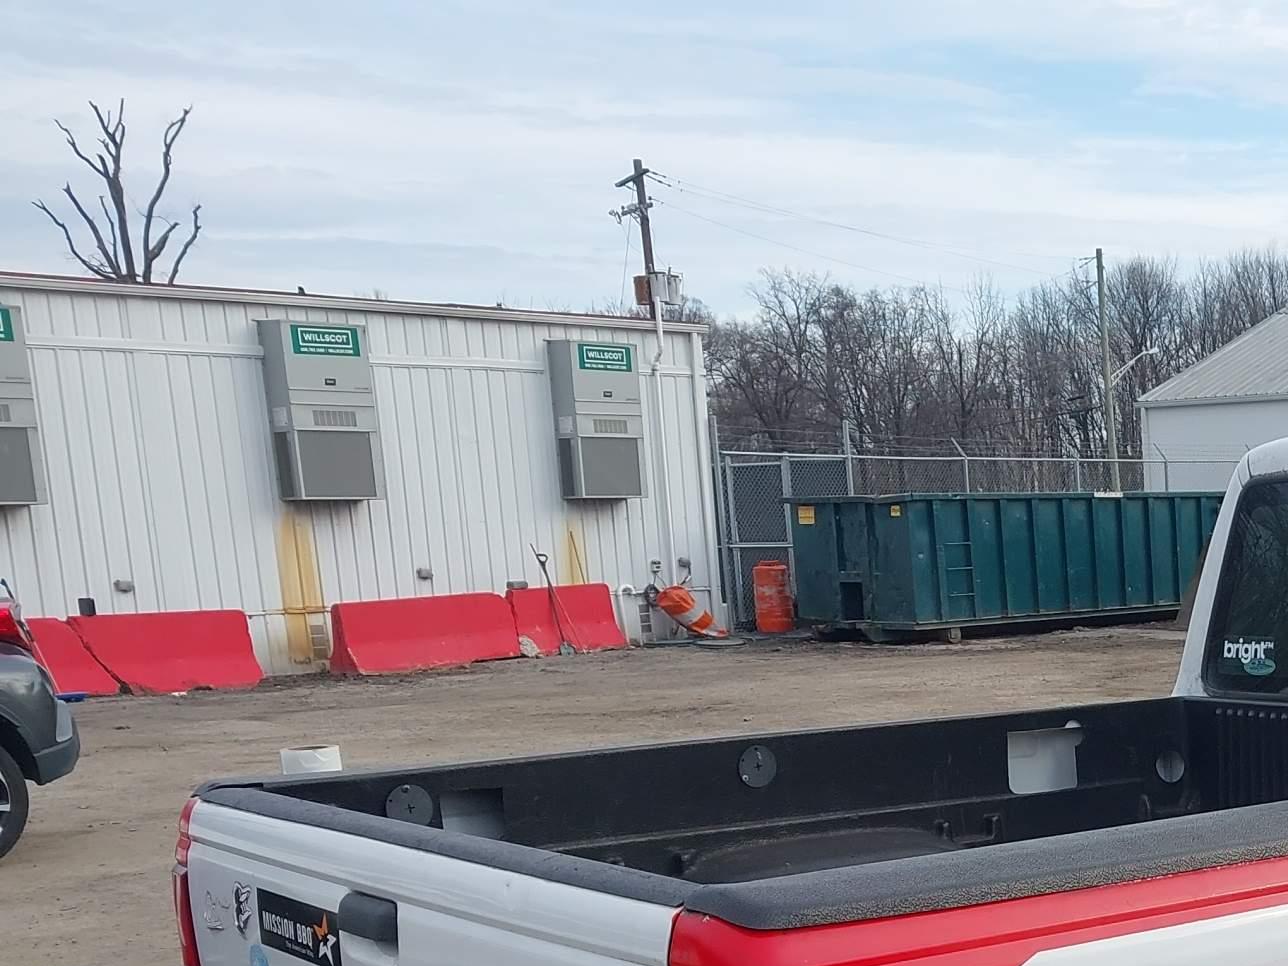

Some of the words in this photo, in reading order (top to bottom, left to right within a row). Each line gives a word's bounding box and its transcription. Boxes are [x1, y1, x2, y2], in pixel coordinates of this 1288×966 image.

[302, 331, 347, 343] WILLSCOT
[586, 350, 623, 360] WILLSCOT
[262, 910, 295, 941] MISSION
[296, 922, 313, 950] BBQ
